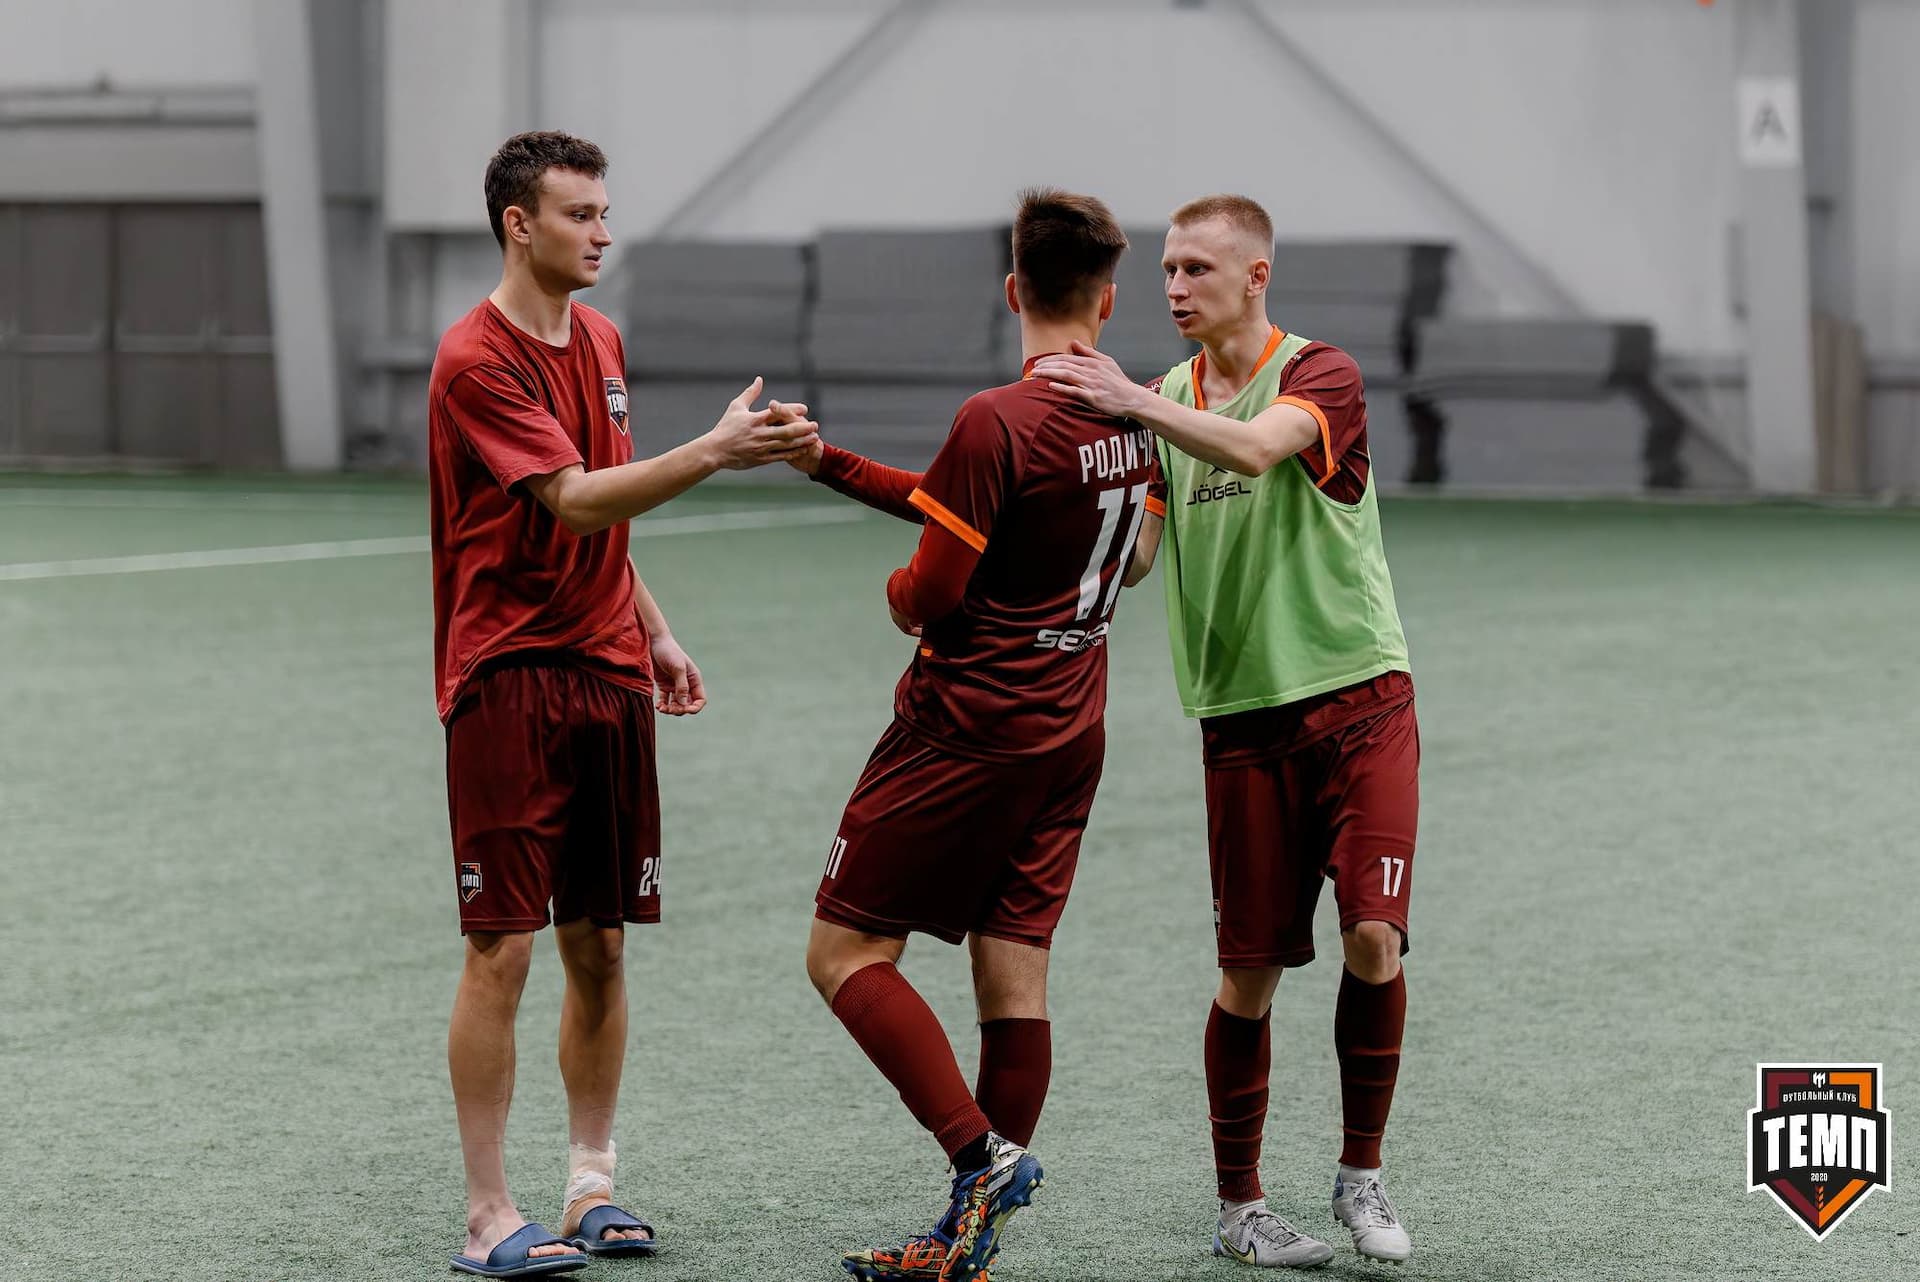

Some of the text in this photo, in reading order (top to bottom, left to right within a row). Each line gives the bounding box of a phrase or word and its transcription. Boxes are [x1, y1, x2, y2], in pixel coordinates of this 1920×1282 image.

[1187, 481, 1251, 505] JÖGEL
[1074, 482, 1149, 620] 11
[639, 857, 661, 896] 24
[826, 836, 848, 880] 11
[1381, 857, 1405, 897] 17
